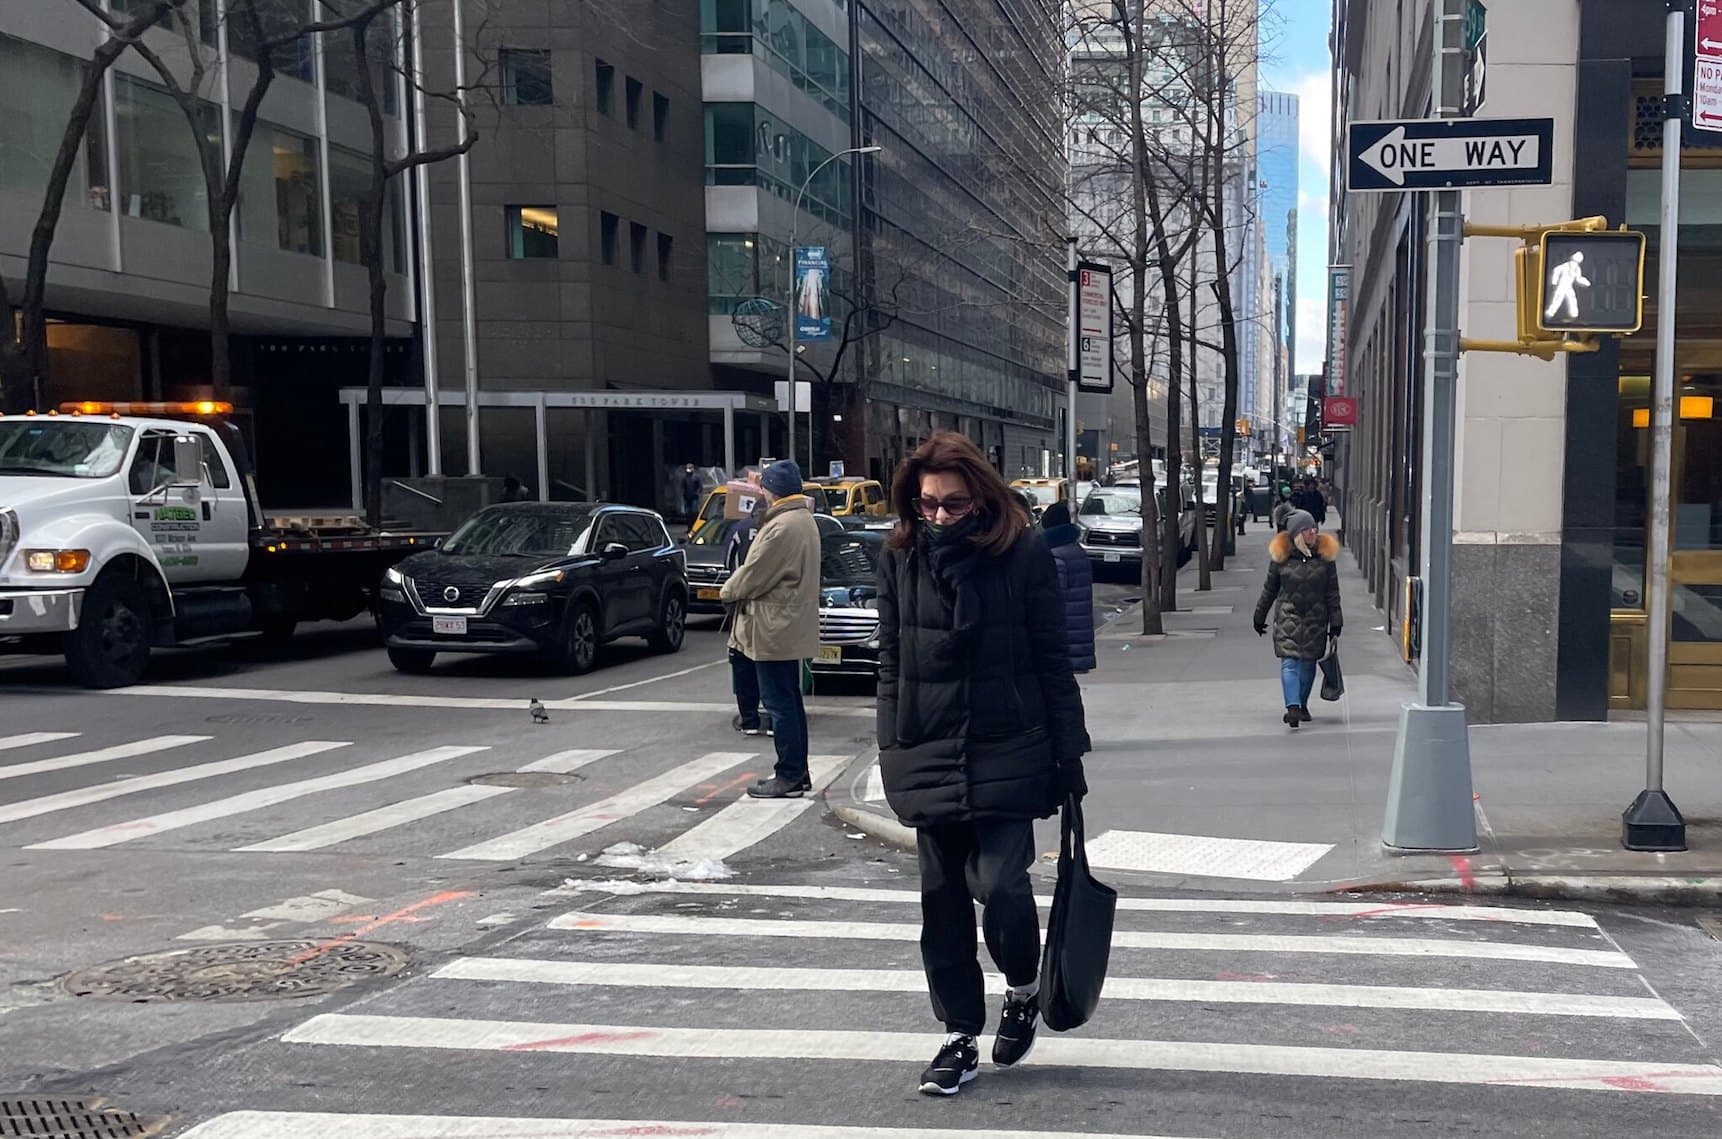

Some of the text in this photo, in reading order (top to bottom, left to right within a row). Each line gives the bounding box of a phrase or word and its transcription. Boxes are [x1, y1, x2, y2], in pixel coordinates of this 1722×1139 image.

[1700, 68, 1713, 80] NO
[1380, 140, 1527, 168] ONE WAY
